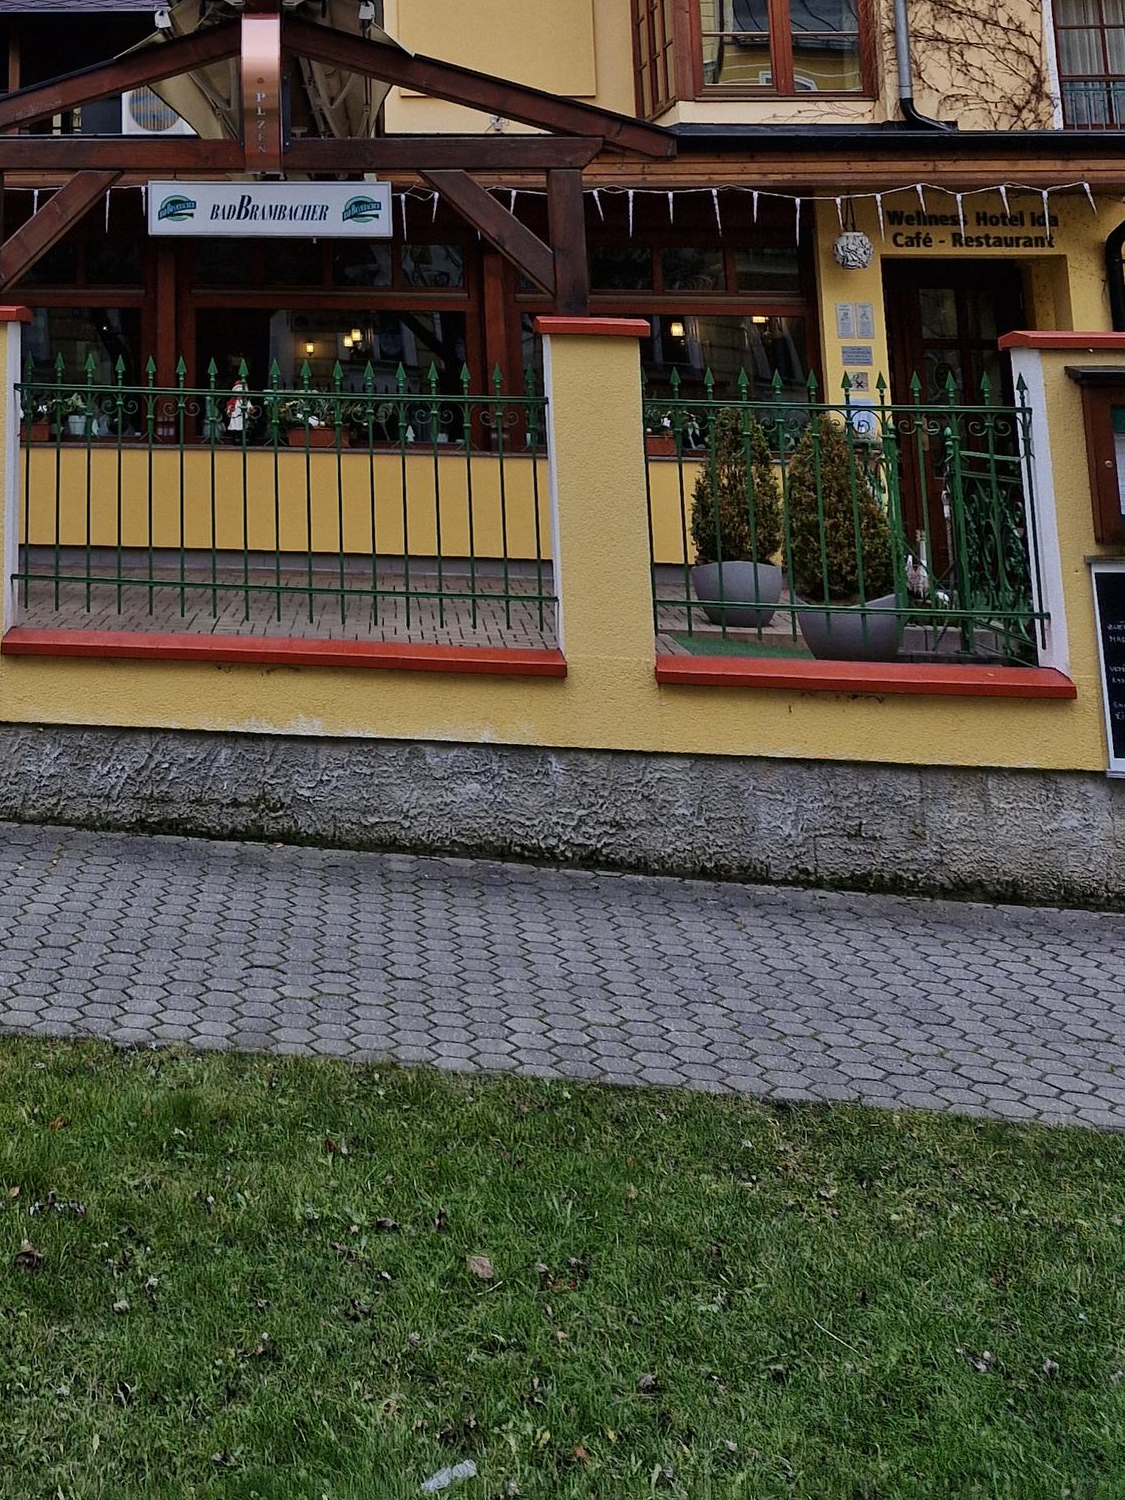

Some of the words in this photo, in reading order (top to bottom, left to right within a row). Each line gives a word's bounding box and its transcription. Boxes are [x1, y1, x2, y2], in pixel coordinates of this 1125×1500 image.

[886, 210, 967, 227] Wellness
[976, 211, 1024, 227] Hotel
[1030, 211, 1059, 227] Ida
[892, 232, 933, 248] Café
[951, 232, 1055, 248] Restaurant
